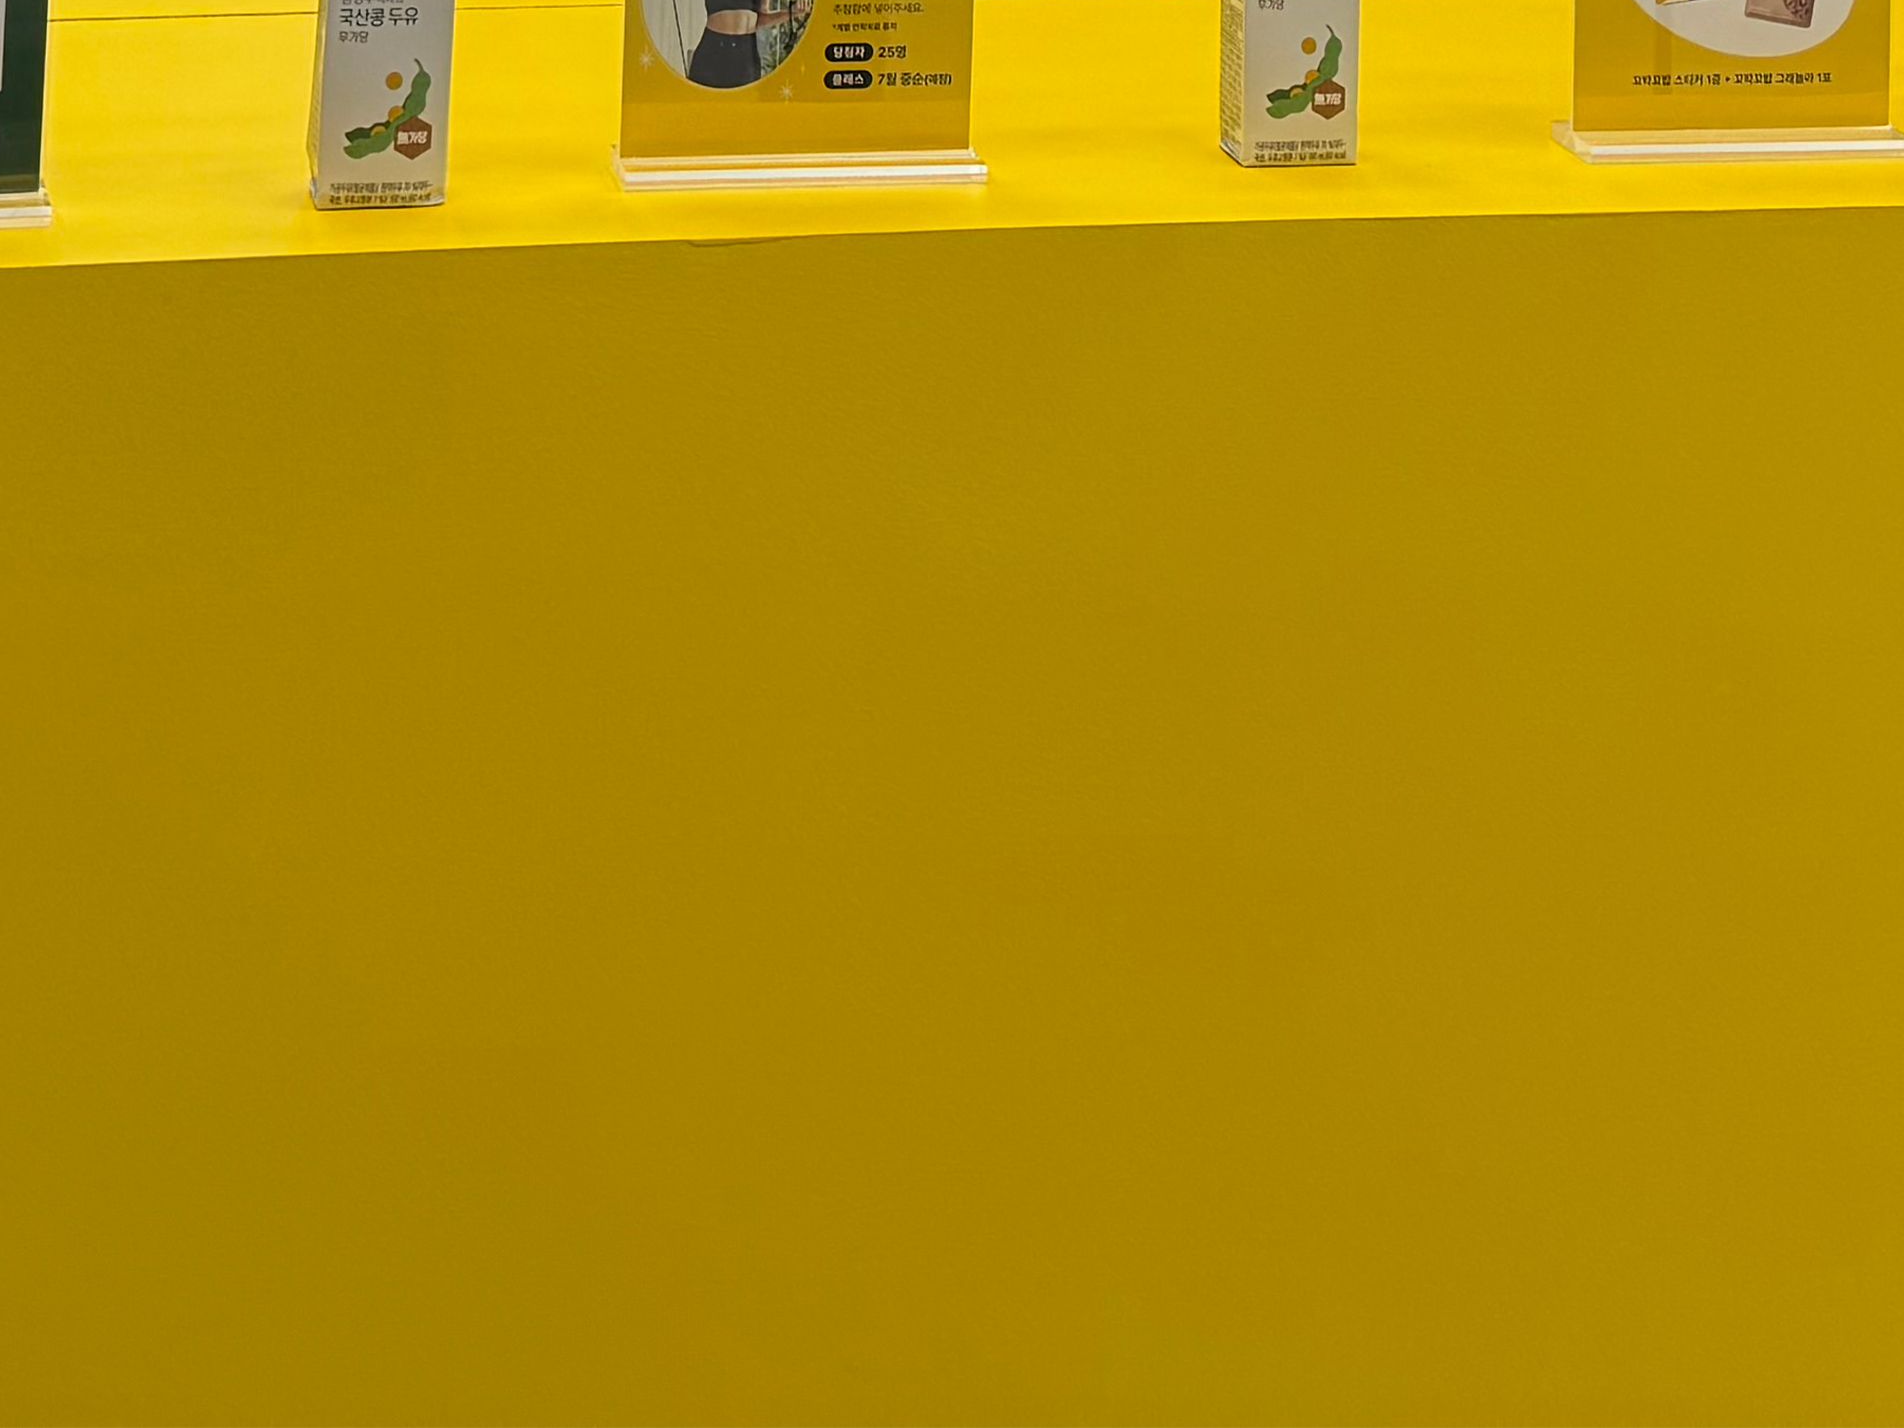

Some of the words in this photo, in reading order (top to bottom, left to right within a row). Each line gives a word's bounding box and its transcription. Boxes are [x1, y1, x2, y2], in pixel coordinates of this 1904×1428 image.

[339, 8, 385, 26] 국산콩
[388, 7, 418, 25] 두유
[878, 45, 906, 59] 25명
